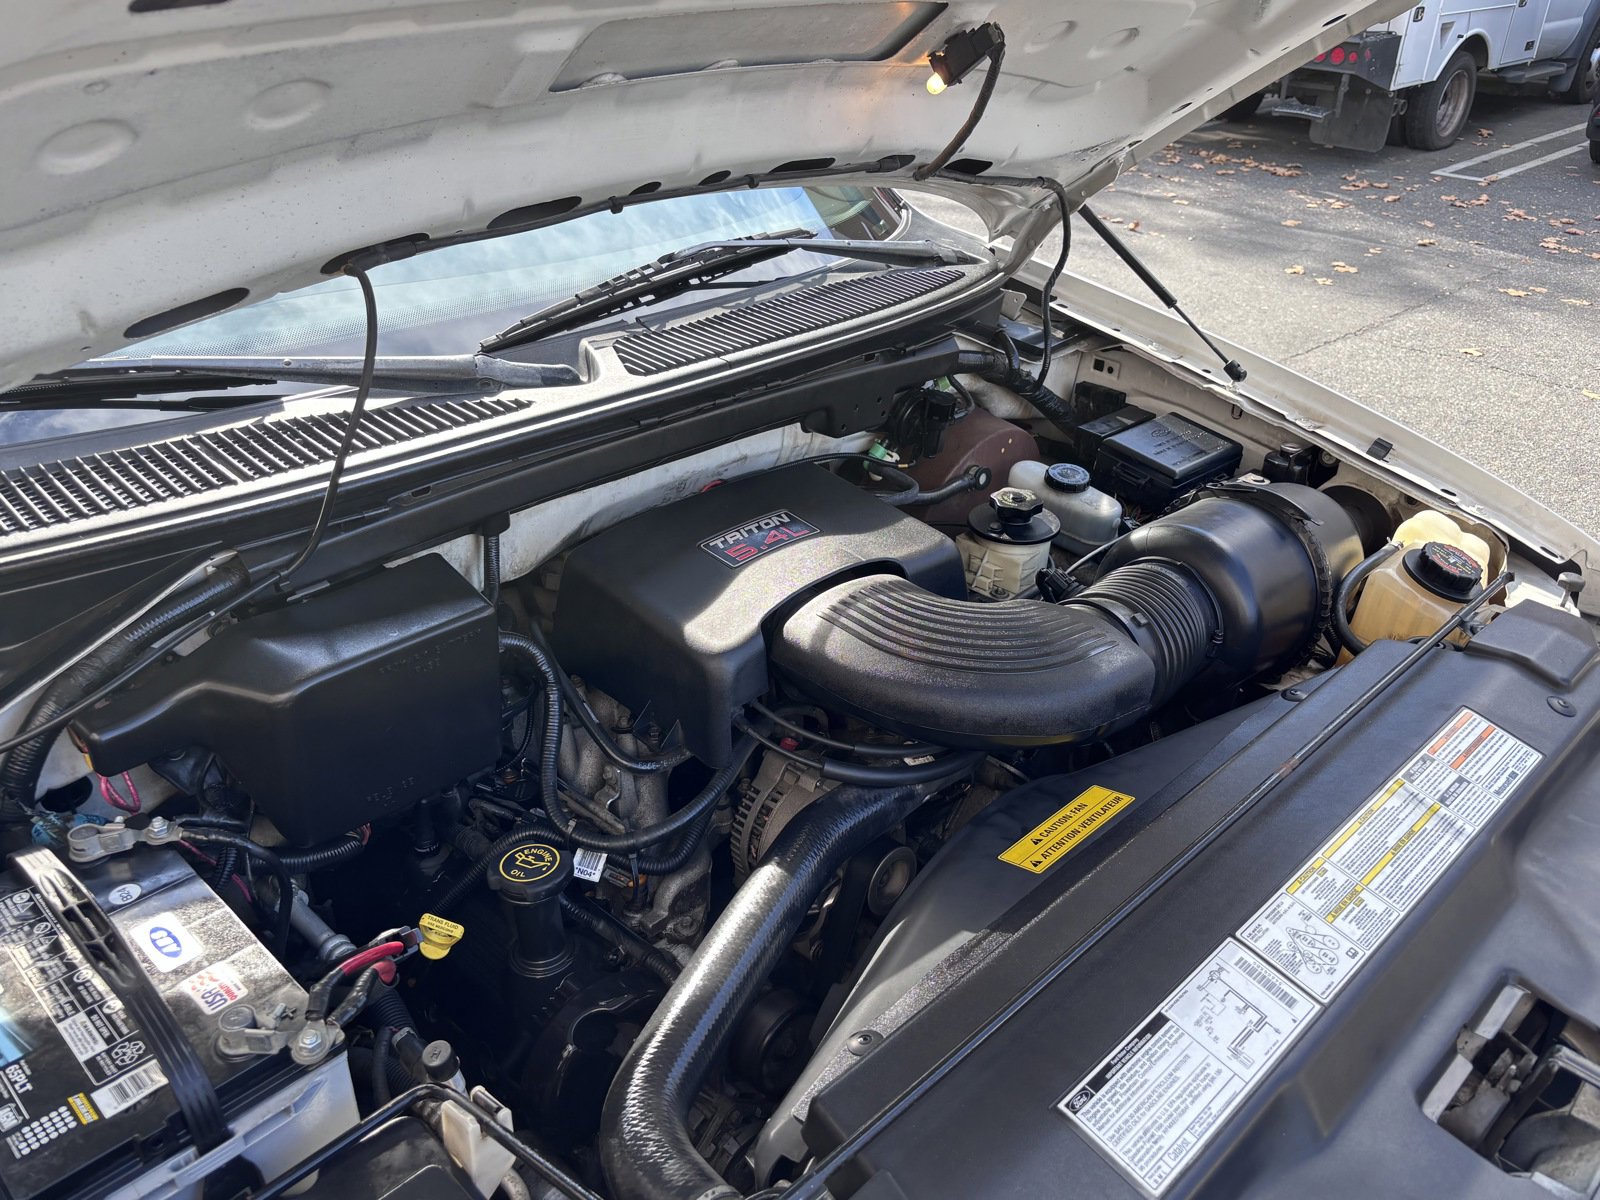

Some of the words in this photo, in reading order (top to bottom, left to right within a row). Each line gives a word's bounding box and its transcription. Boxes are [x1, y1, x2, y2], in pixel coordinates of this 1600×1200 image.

[709, 513, 791, 549] TRITON
[725, 527, 810, 561] 5.4L
[524, 848, 552, 862] ENGINE
[510, 869, 526, 878] OIL
[428, 916, 443, 925] TRANS
[444, 921, 459, 930] FLUID
[201, 986, 228, 1011] USA
[5, 1064, 33, 1094] 65PLT
[1072, 1095, 1088, 1109] Ford
[1131, 1092, 1153, 1115] AMERICAN
[1167, 1137, 1192, 1163] Catalyst
